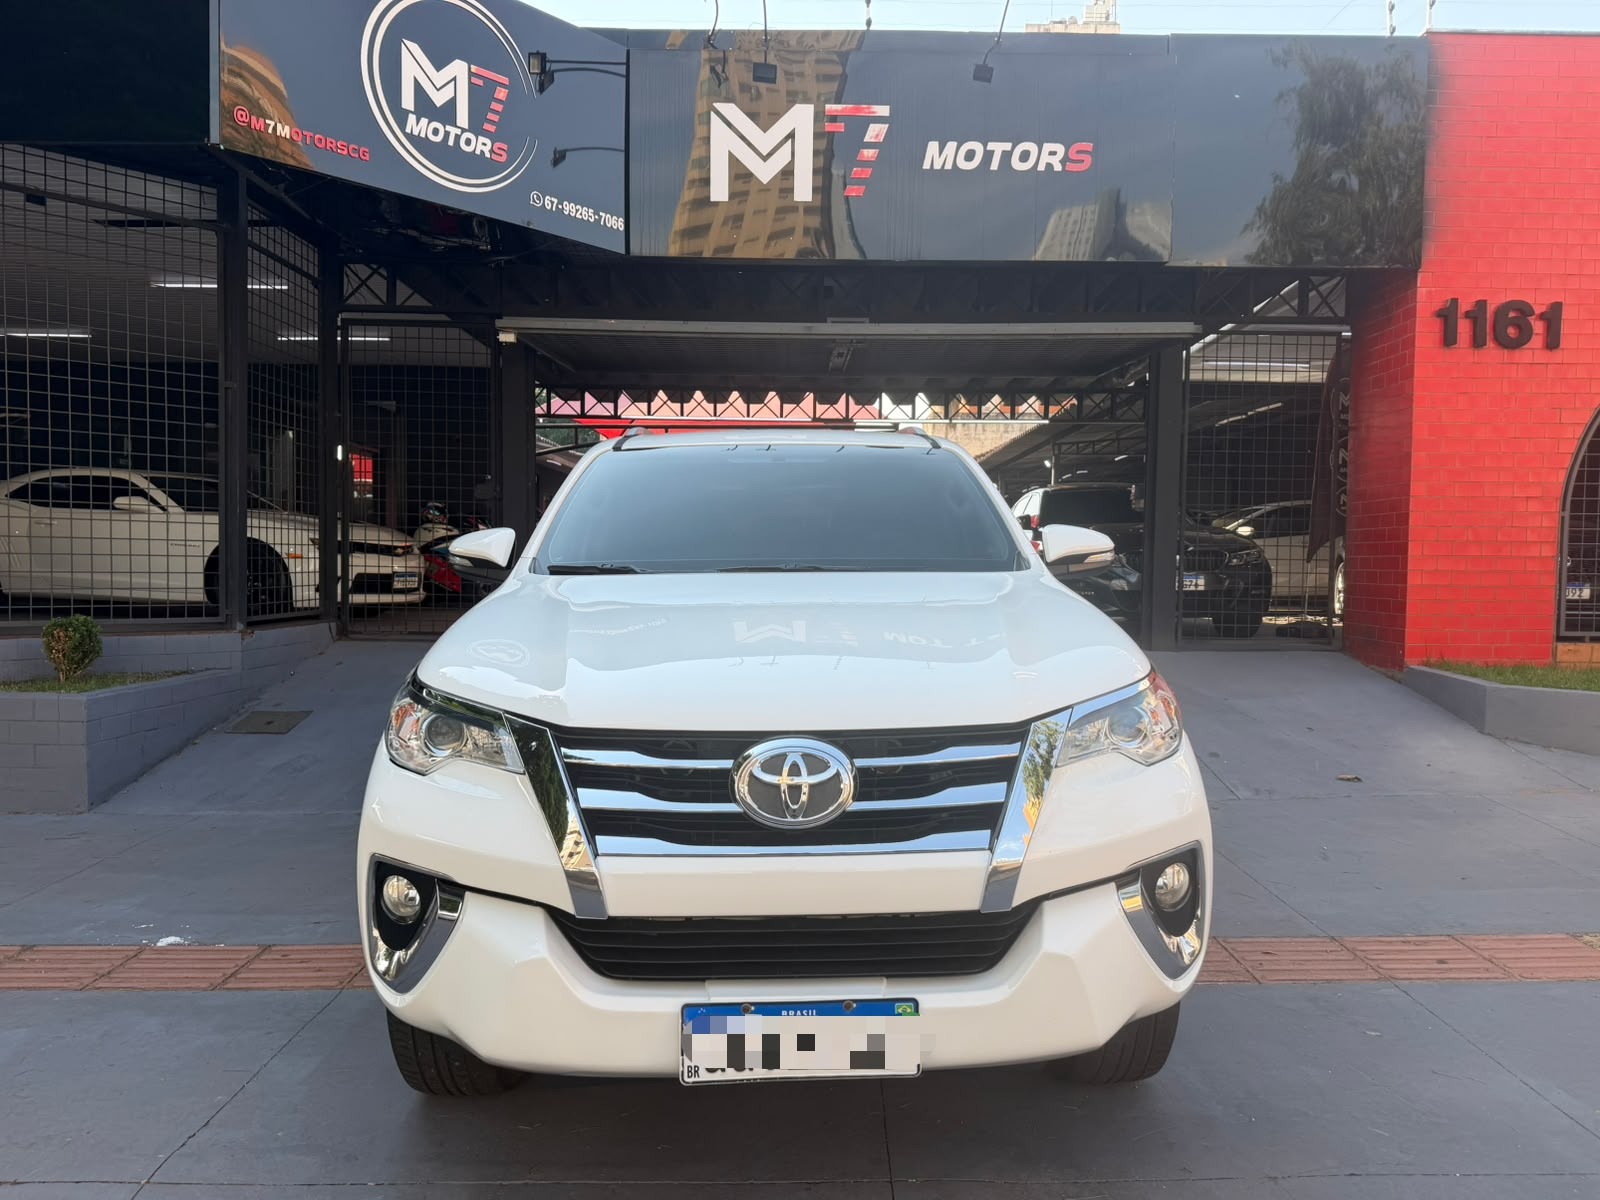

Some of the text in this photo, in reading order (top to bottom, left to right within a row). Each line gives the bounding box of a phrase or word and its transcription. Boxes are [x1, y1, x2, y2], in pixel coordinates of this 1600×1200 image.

[401, 38, 510, 134] M7
[233, 105, 371, 162] @M7MOTORSCG
[404, 112, 508, 163] MOTORS
[709, 102, 1094, 202] M7 MOTORS
[544, 195, 625, 231] 67-99265-7066
[1435, 297, 1564, 351] 1161
[686, 1065, 700, 1079] BR
